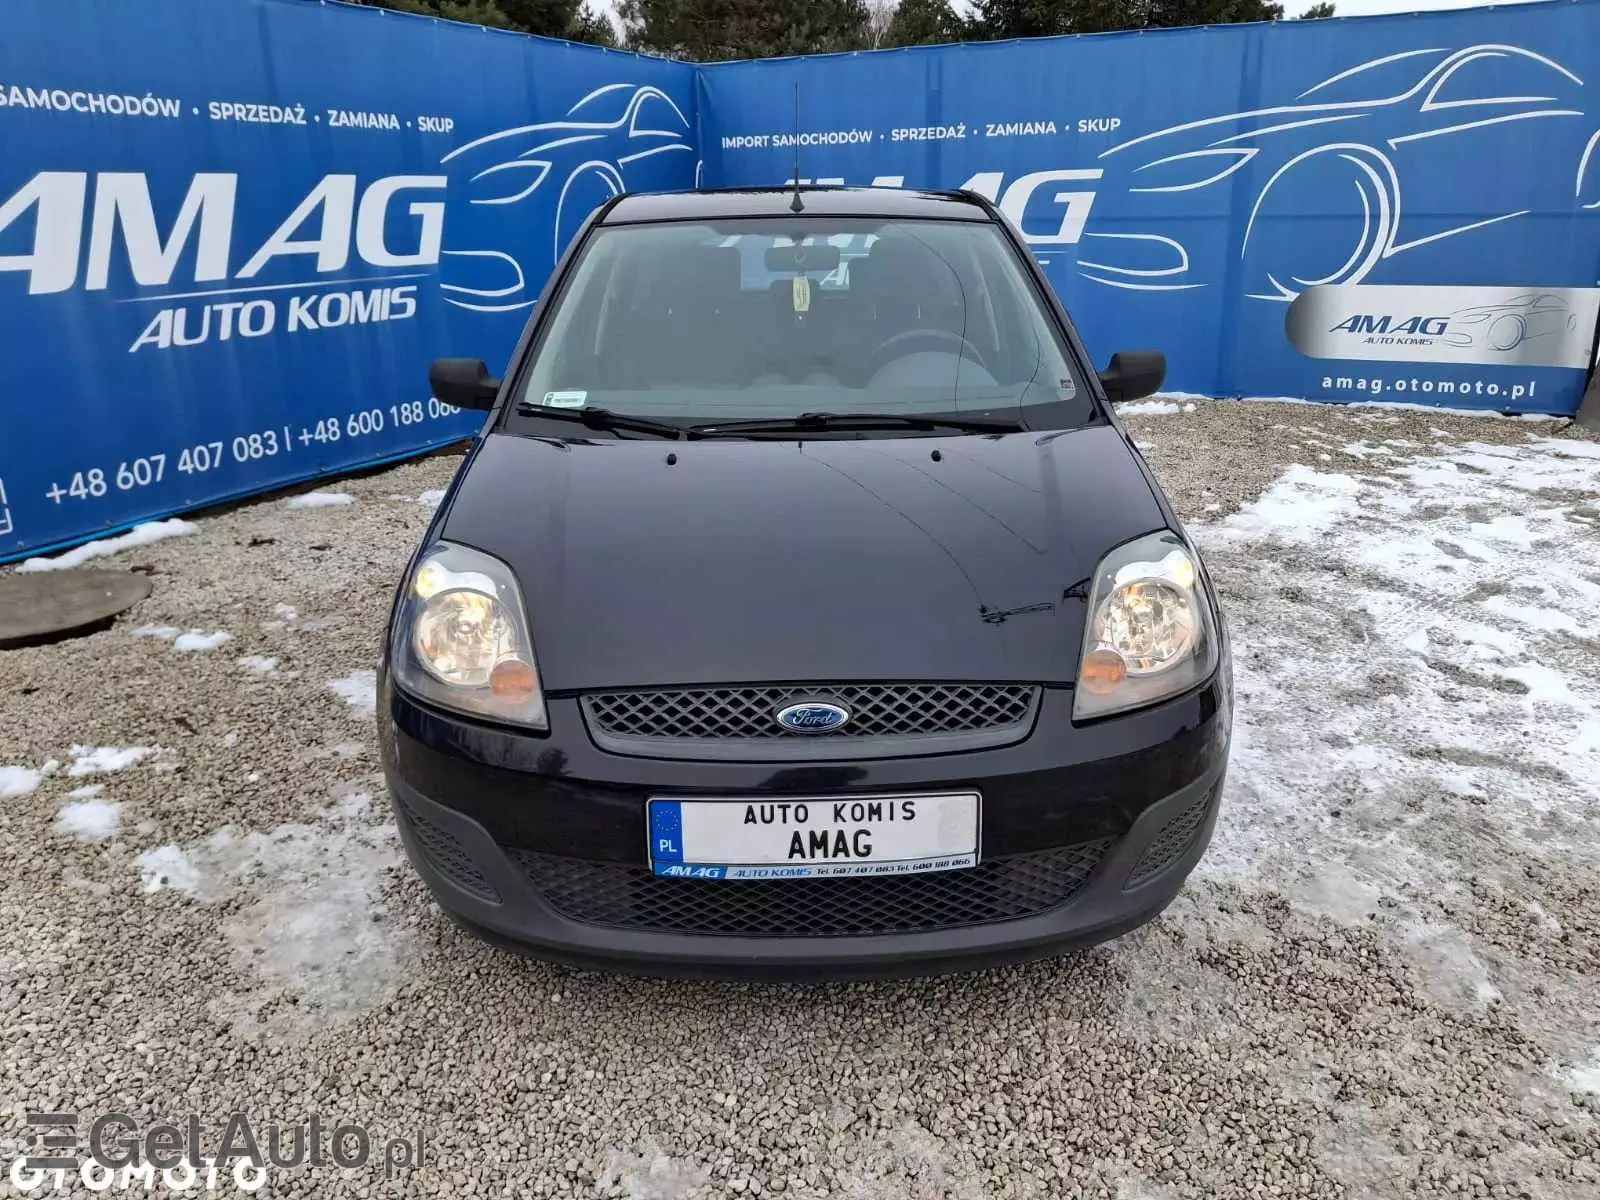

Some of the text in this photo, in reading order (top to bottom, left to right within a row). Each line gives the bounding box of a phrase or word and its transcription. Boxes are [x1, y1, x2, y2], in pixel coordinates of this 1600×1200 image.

[208, 101, 307, 125] SPRZEDAŻ
[328, 109, 400, 131] ZAMIANA
[417, 115, 455, 134] SKUP
[721, 117, 1121, 149] IMPORT SAMOCHODÓW SPRZEDAŻ ZAMIANA SKUP
[128, 285, 418, 353] AUTO KOMIS
[1361, 336, 1433, 346] AUTO KOMIS
[1321, 374, 1537, 400] amag.otomoto.pl
[45, 468, 108, 505] +48
[116, 454, 167, 490] 607
[177, 442, 224, 475] 407
[232, 430, 279, 464] 083
[298, 418, 341, 448] +48
[346, 409, 384, 438] 600
[389, 400, 425, 428] 188
[792, 708, 833, 725] Ford
[744, 801, 916, 825] AUTO KOMIS
[659, 839, 677, 853] PL
[787, 829, 873, 859] AMAG
[771, 867, 812, 877] KOMIS
